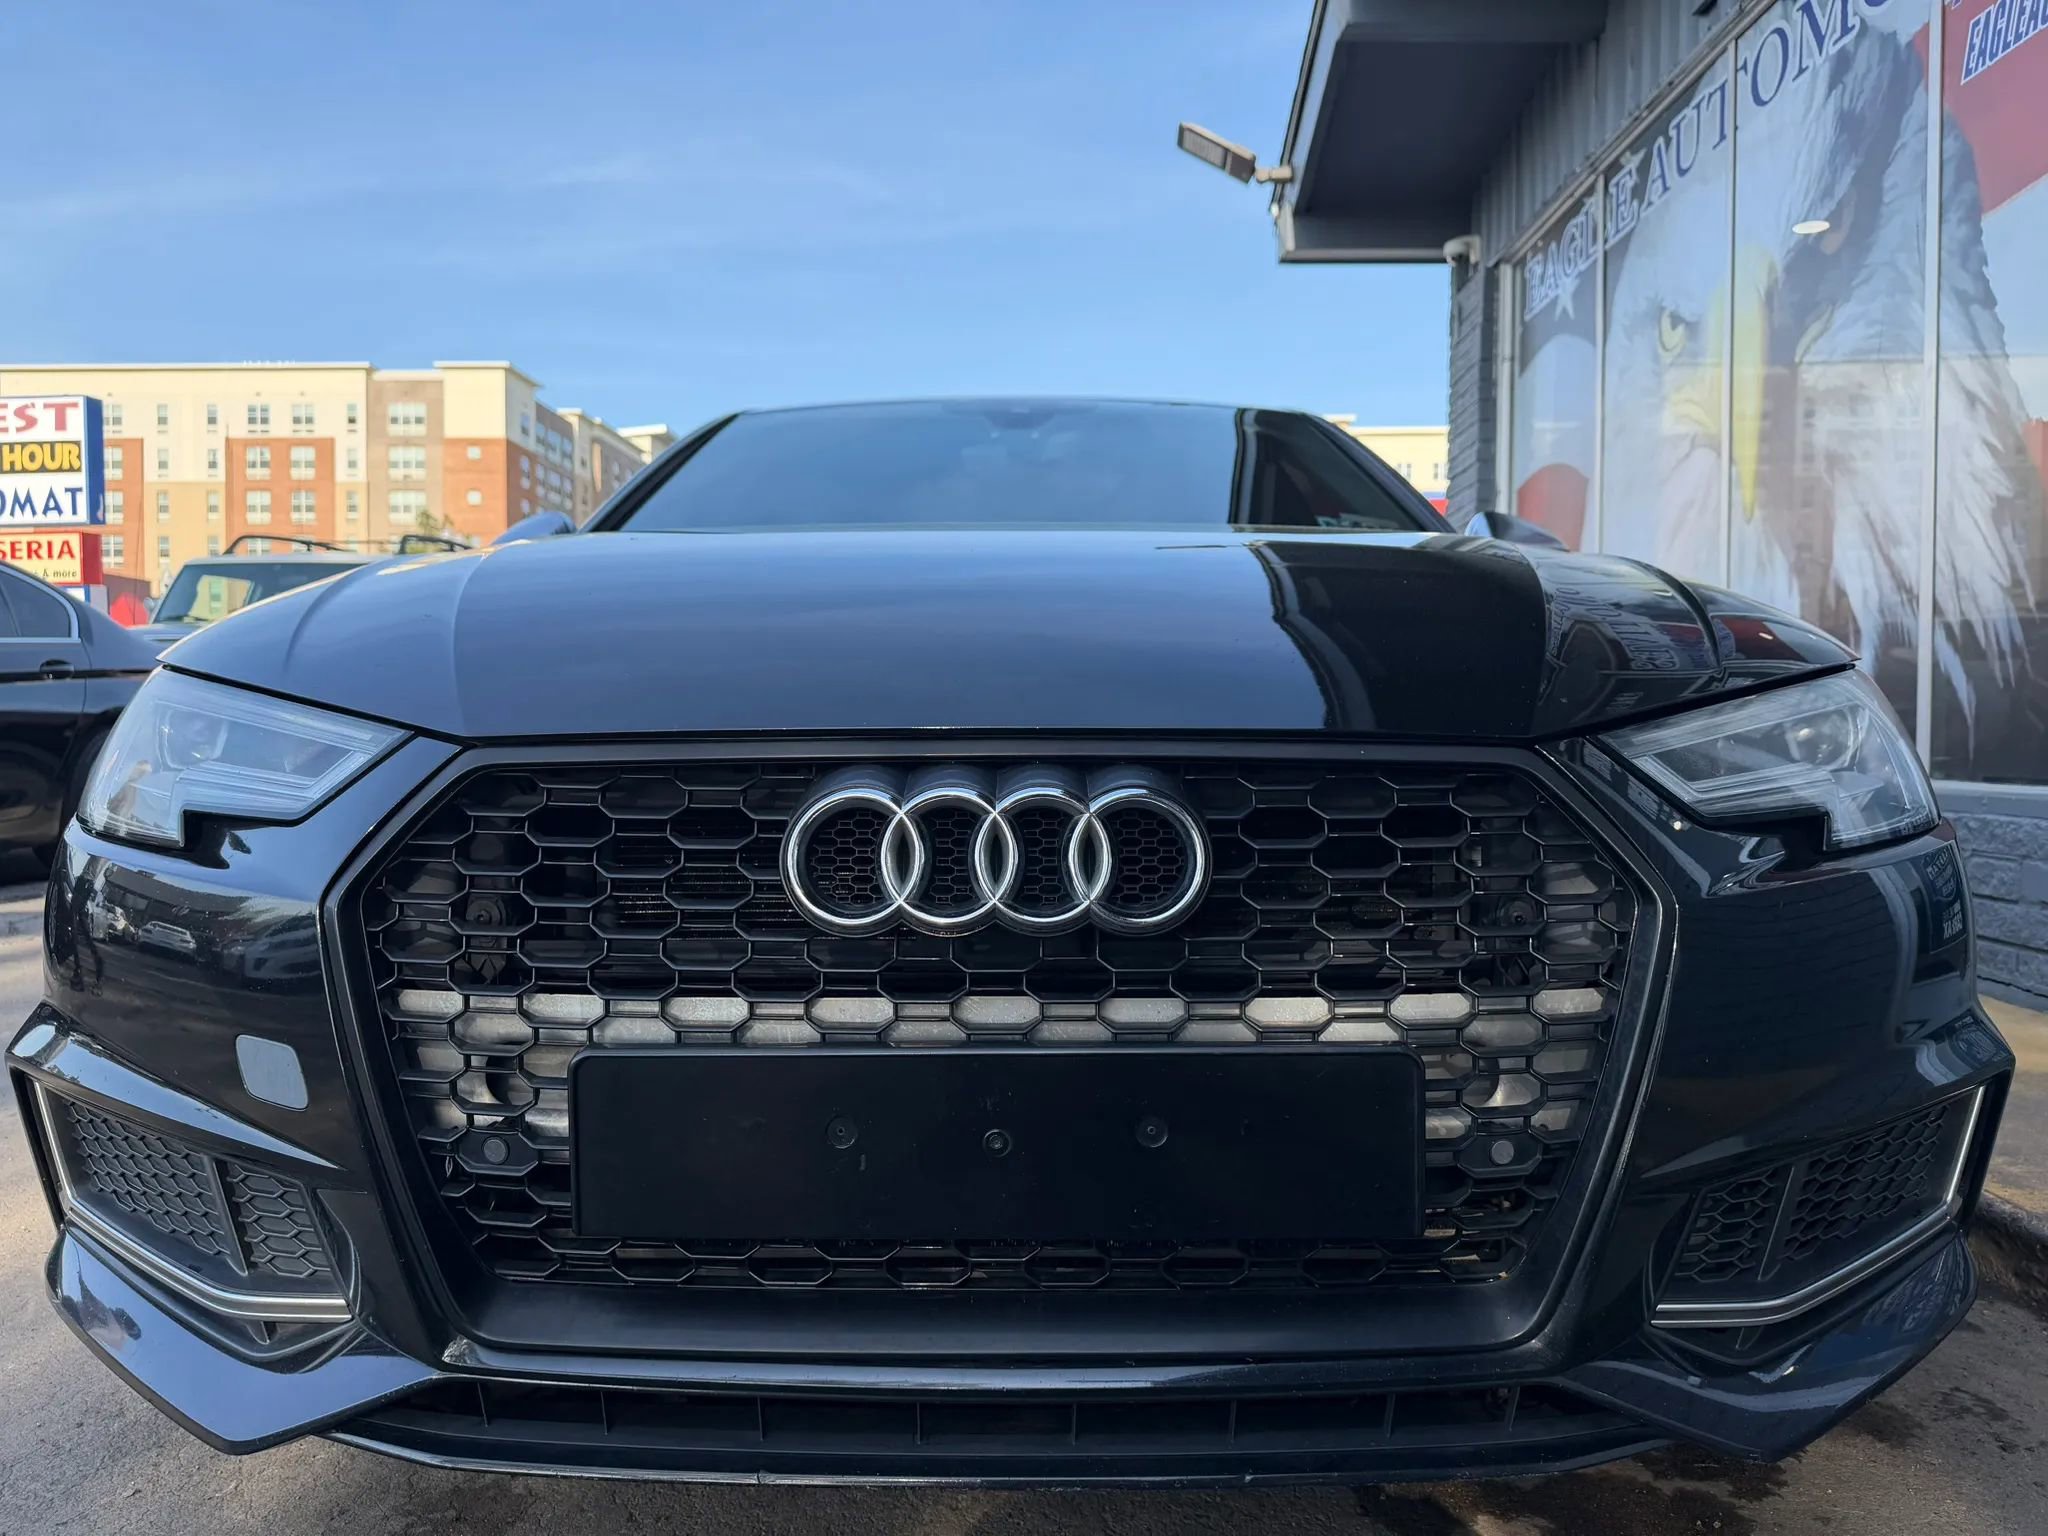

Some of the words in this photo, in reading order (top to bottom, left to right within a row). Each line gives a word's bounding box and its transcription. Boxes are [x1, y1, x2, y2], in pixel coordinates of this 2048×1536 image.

[1525, 166, 1640, 321] EAGLE
[1641, 0, 1892, 213] AUTOM
[2, 442, 81, 472] HOUR
